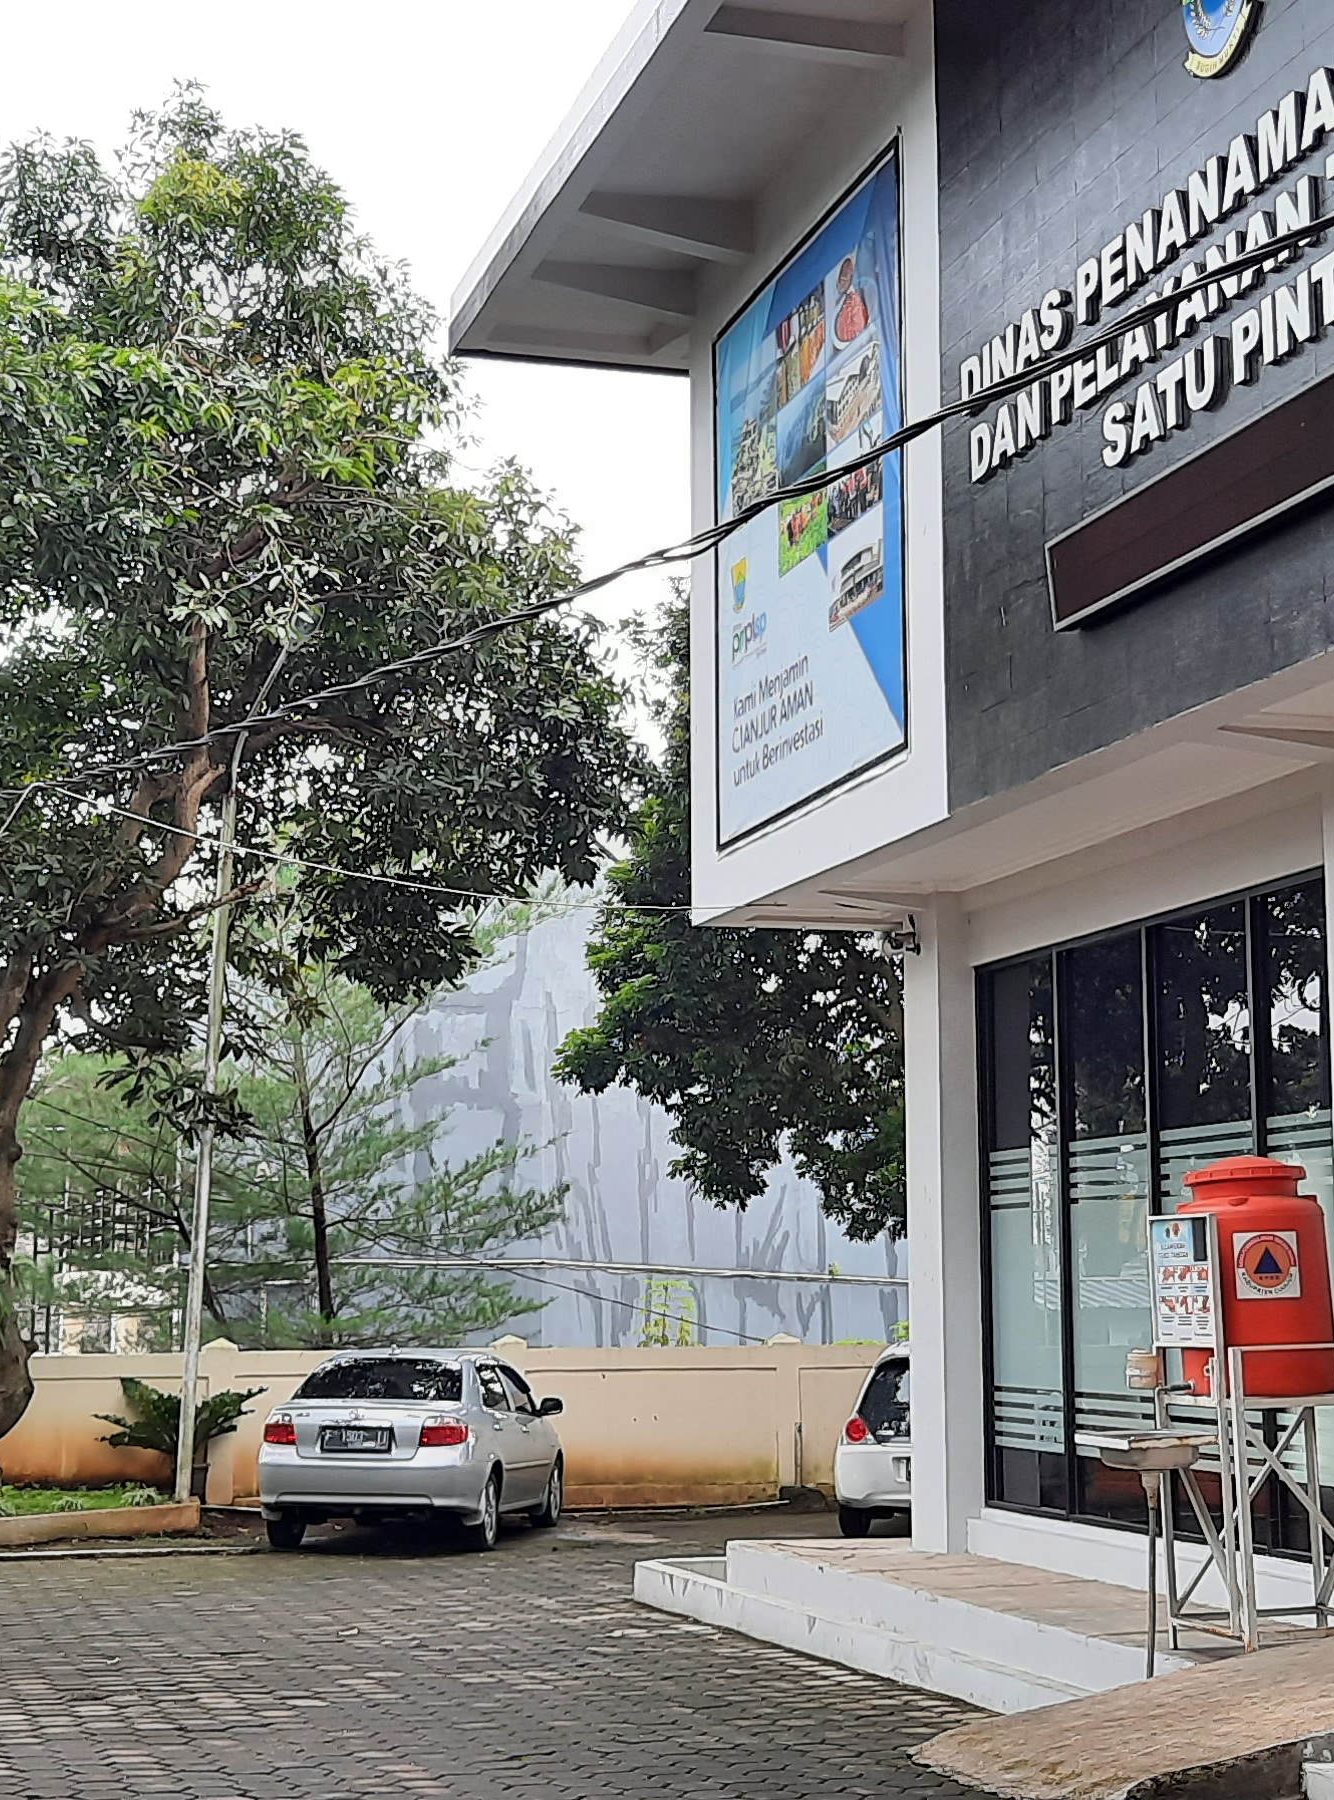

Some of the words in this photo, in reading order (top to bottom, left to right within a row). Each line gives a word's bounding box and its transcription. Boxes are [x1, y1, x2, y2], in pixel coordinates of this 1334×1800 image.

[960, 288, 1066, 416] DINAS
[970, 379, 1043, 484] DAN
[1051, 175, 1313, 426] PELAYANAN
[1101, 334, 1220, 468] SATU
[732, 704, 777, 753] CIANJUR
[779, 680, 814, 726] AMAN
[733, 683, 757, 720] Kami
[758, 653, 809, 706] Menjamin
[733, 751, 760, 788] untuk
[762, 710, 824, 771] Berinvestasi
